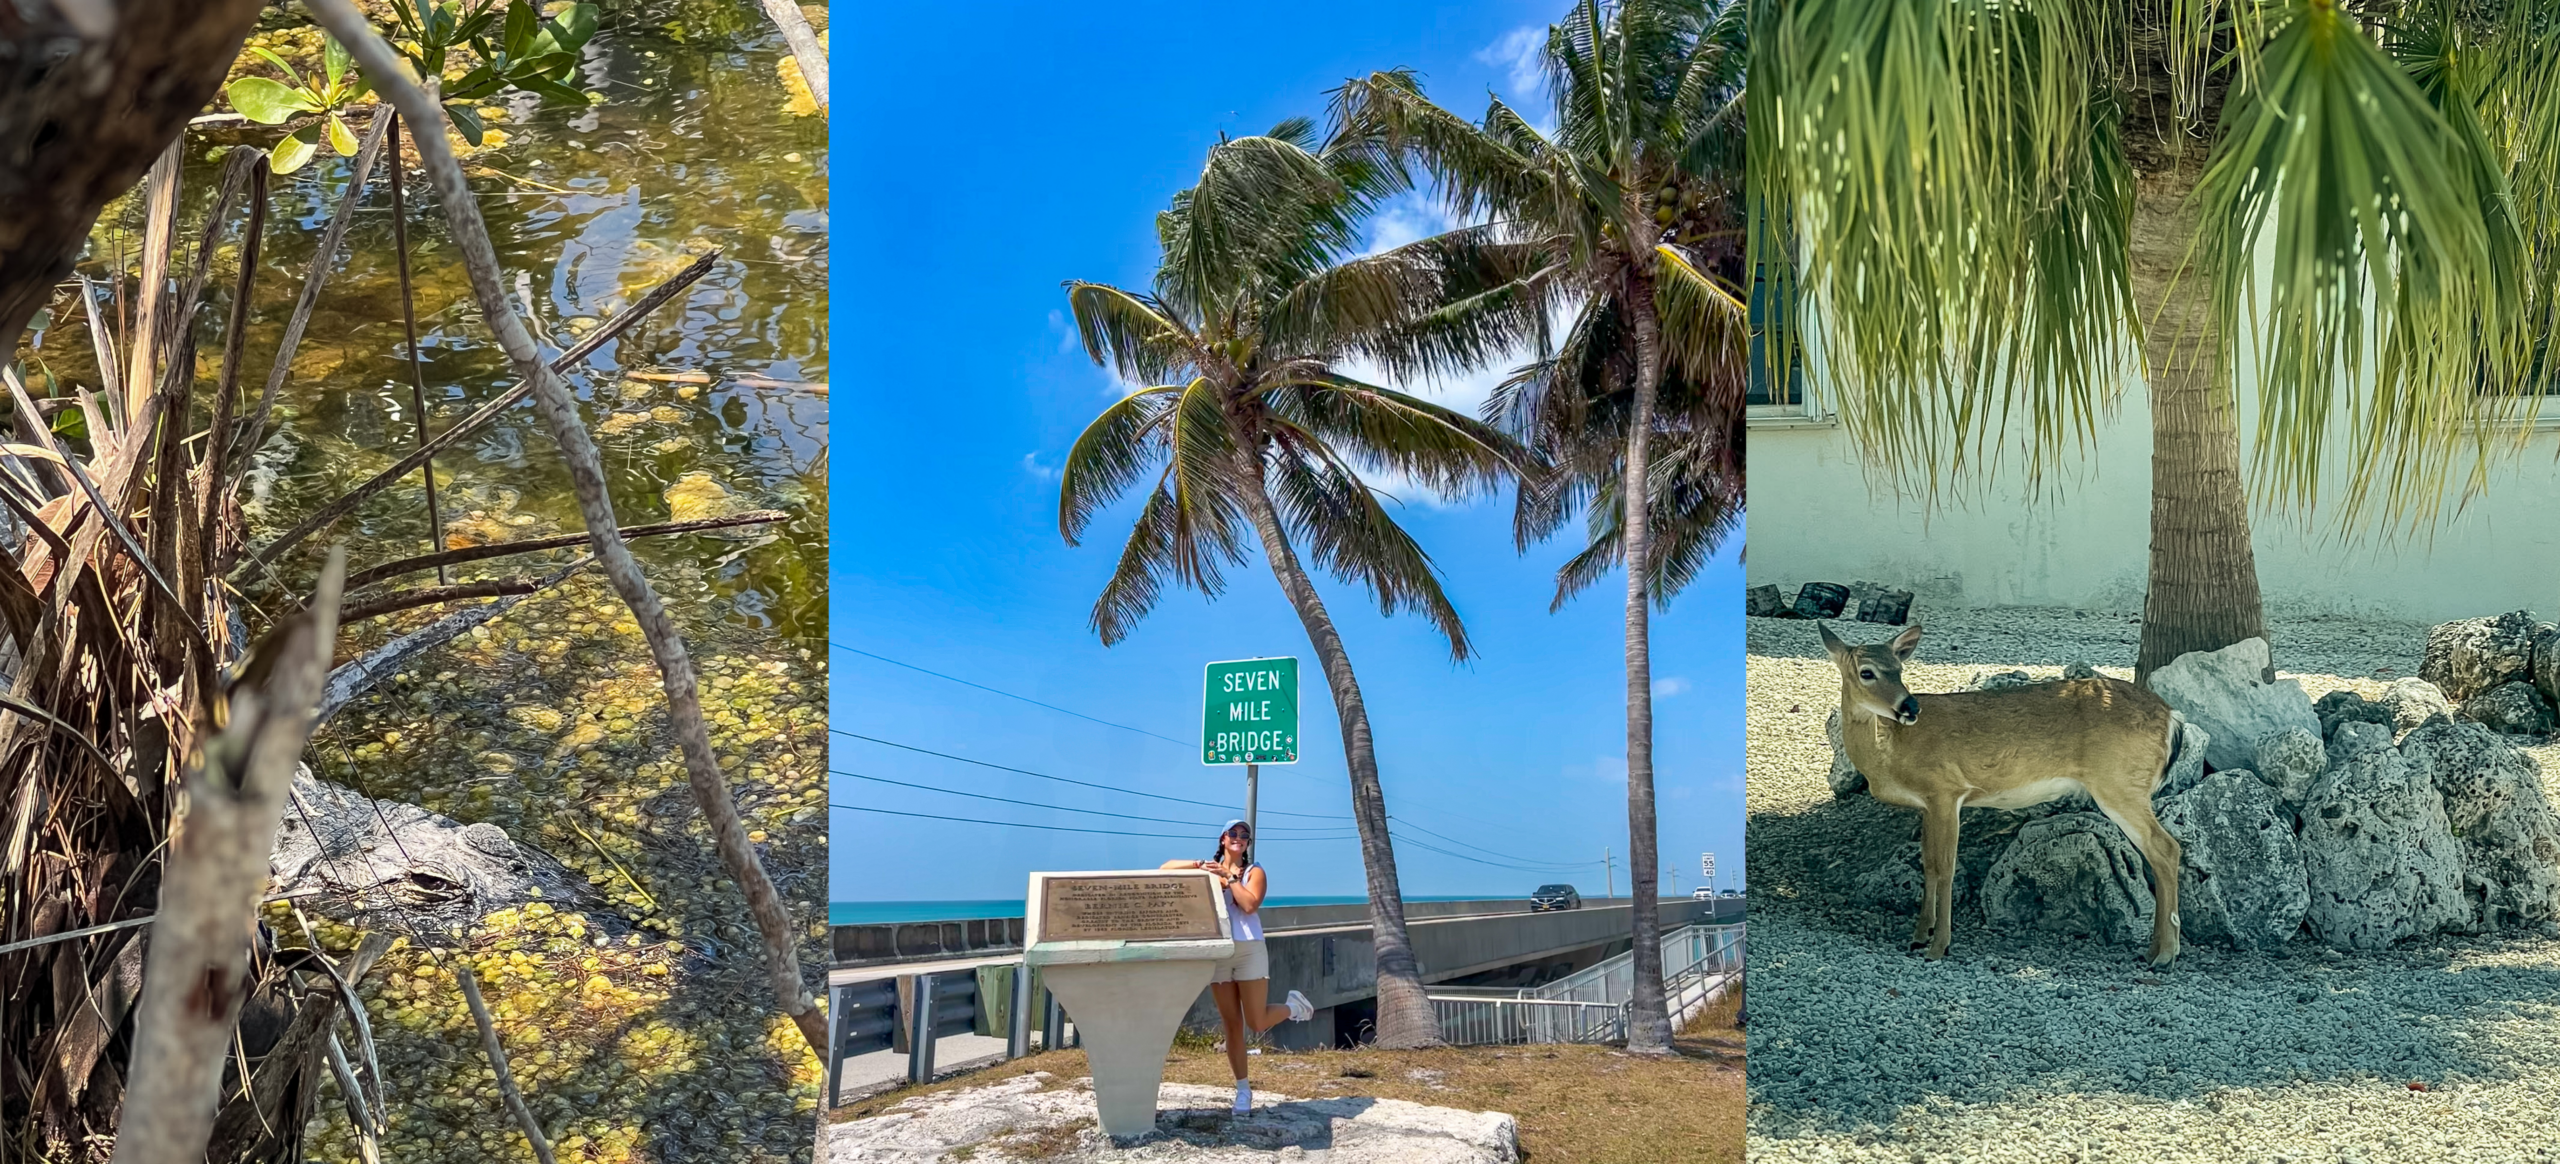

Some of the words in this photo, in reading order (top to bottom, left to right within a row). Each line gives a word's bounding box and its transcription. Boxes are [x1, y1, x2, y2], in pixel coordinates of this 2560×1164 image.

[1223, 670, 1280, 693] SEVEN
[1229, 700, 1271, 721] MILE
[1217, 731, 1283, 752] BRIDGE
